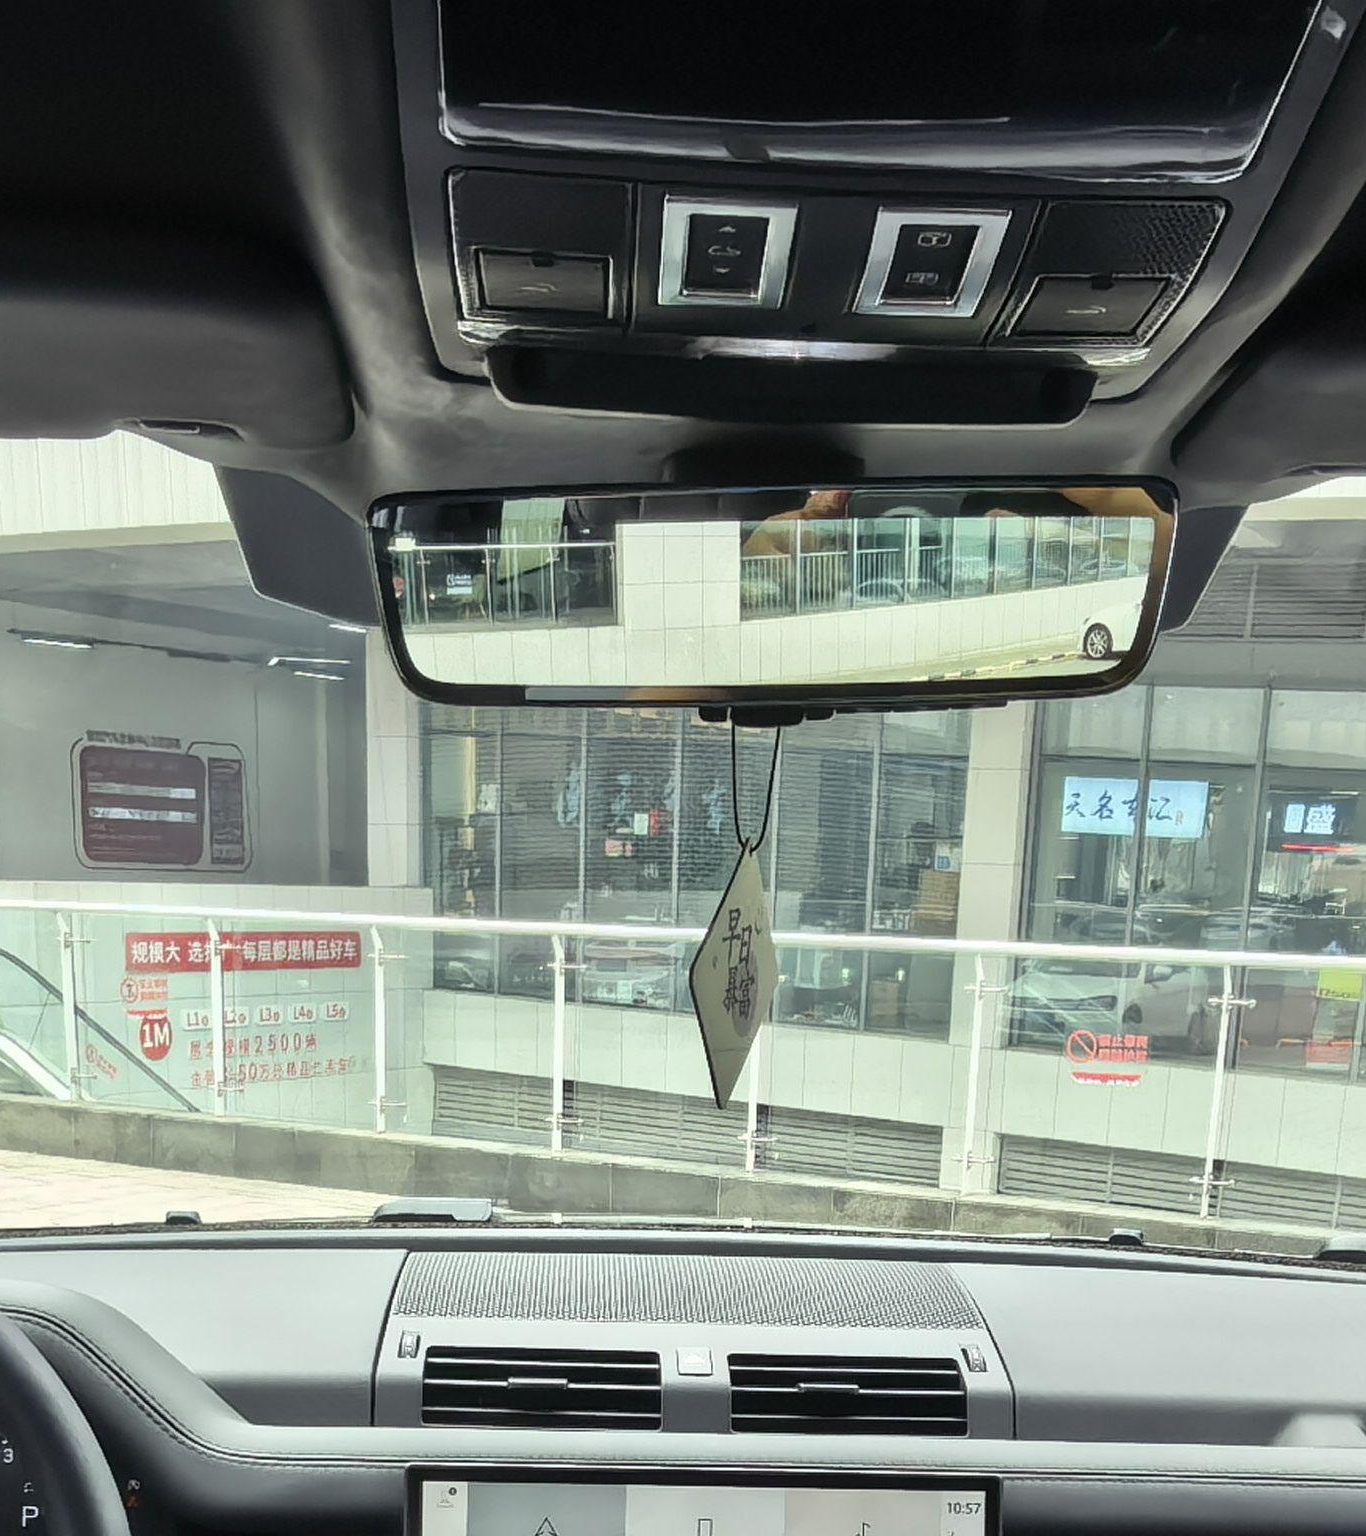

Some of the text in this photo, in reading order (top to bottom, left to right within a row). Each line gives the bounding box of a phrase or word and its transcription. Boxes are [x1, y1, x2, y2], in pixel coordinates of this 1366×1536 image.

[3, 1448, 14, 1463] 3
[22, 1505, 39, 1527] P
[947, 1502, 981, 1515] 10:57
